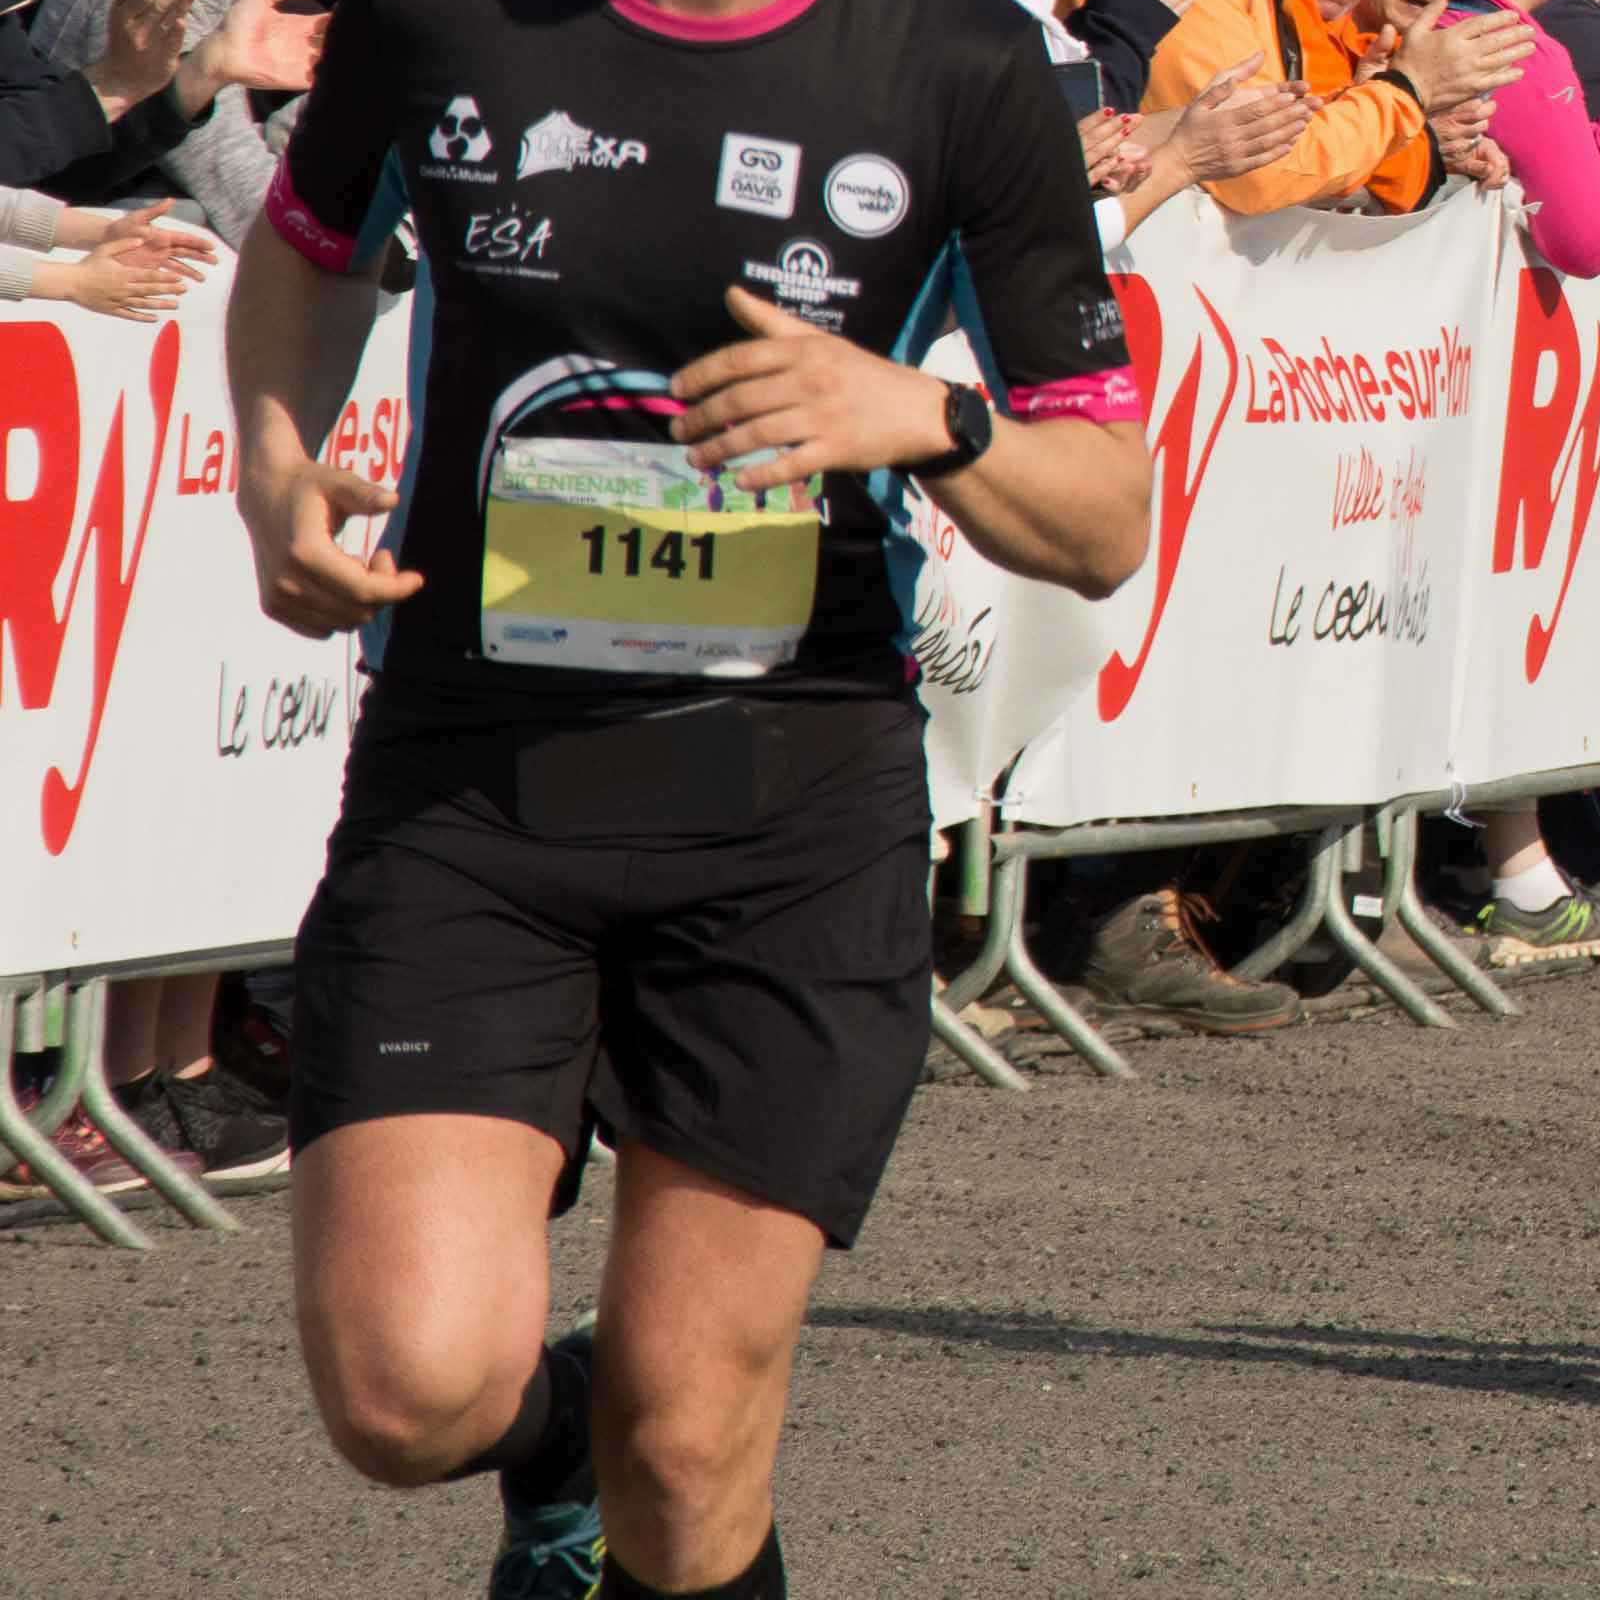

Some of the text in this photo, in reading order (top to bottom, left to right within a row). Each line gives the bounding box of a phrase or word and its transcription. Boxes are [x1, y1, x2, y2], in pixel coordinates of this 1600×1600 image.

[731, 178, 783, 201] DAVID
[465, 215, 553, 261] ESA
[744, 261, 860, 297] ENDURANCE
[176, 412, 226, 496] La
[580, 523, 716, 581] 1141
[1269, 563, 1304, 646] Le
[217, 662, 249, 758] Le
